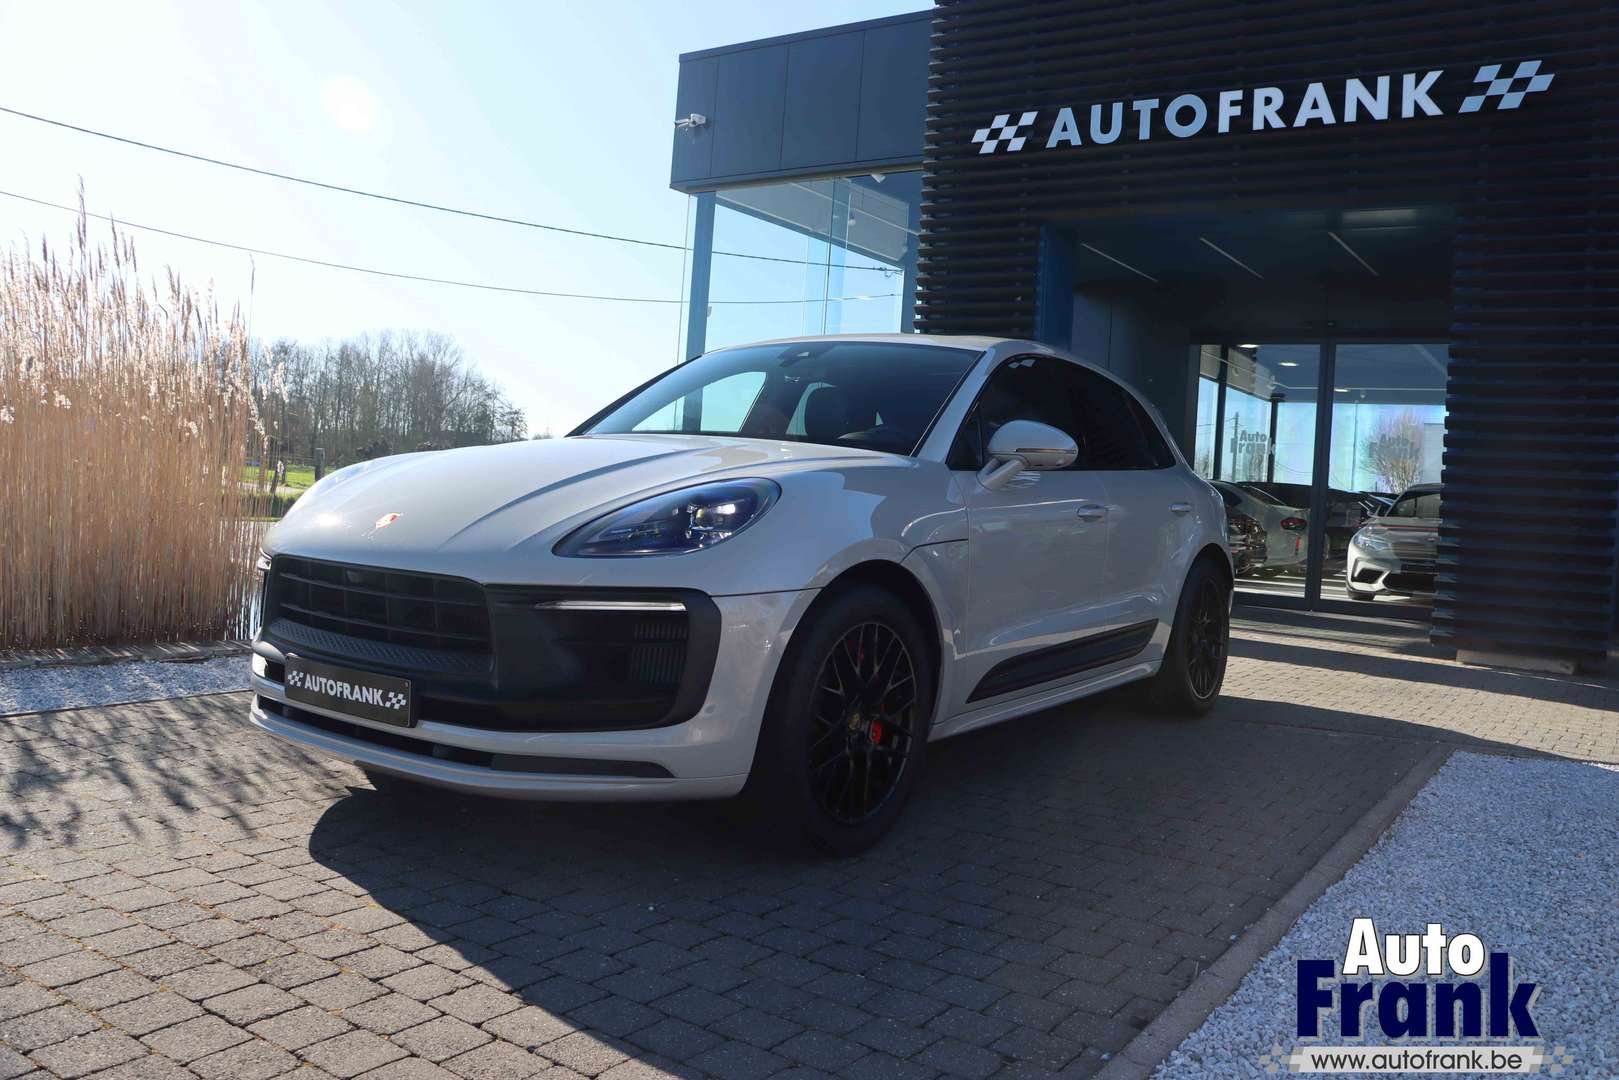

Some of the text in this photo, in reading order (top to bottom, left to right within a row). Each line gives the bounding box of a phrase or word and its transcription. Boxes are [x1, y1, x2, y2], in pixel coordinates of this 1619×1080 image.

[1045, 70, 1444, 148] AUTOFRANK
[1239, 430, 1268, 443] Auto
[304, 673, 384, 707] AUTOFRANK
